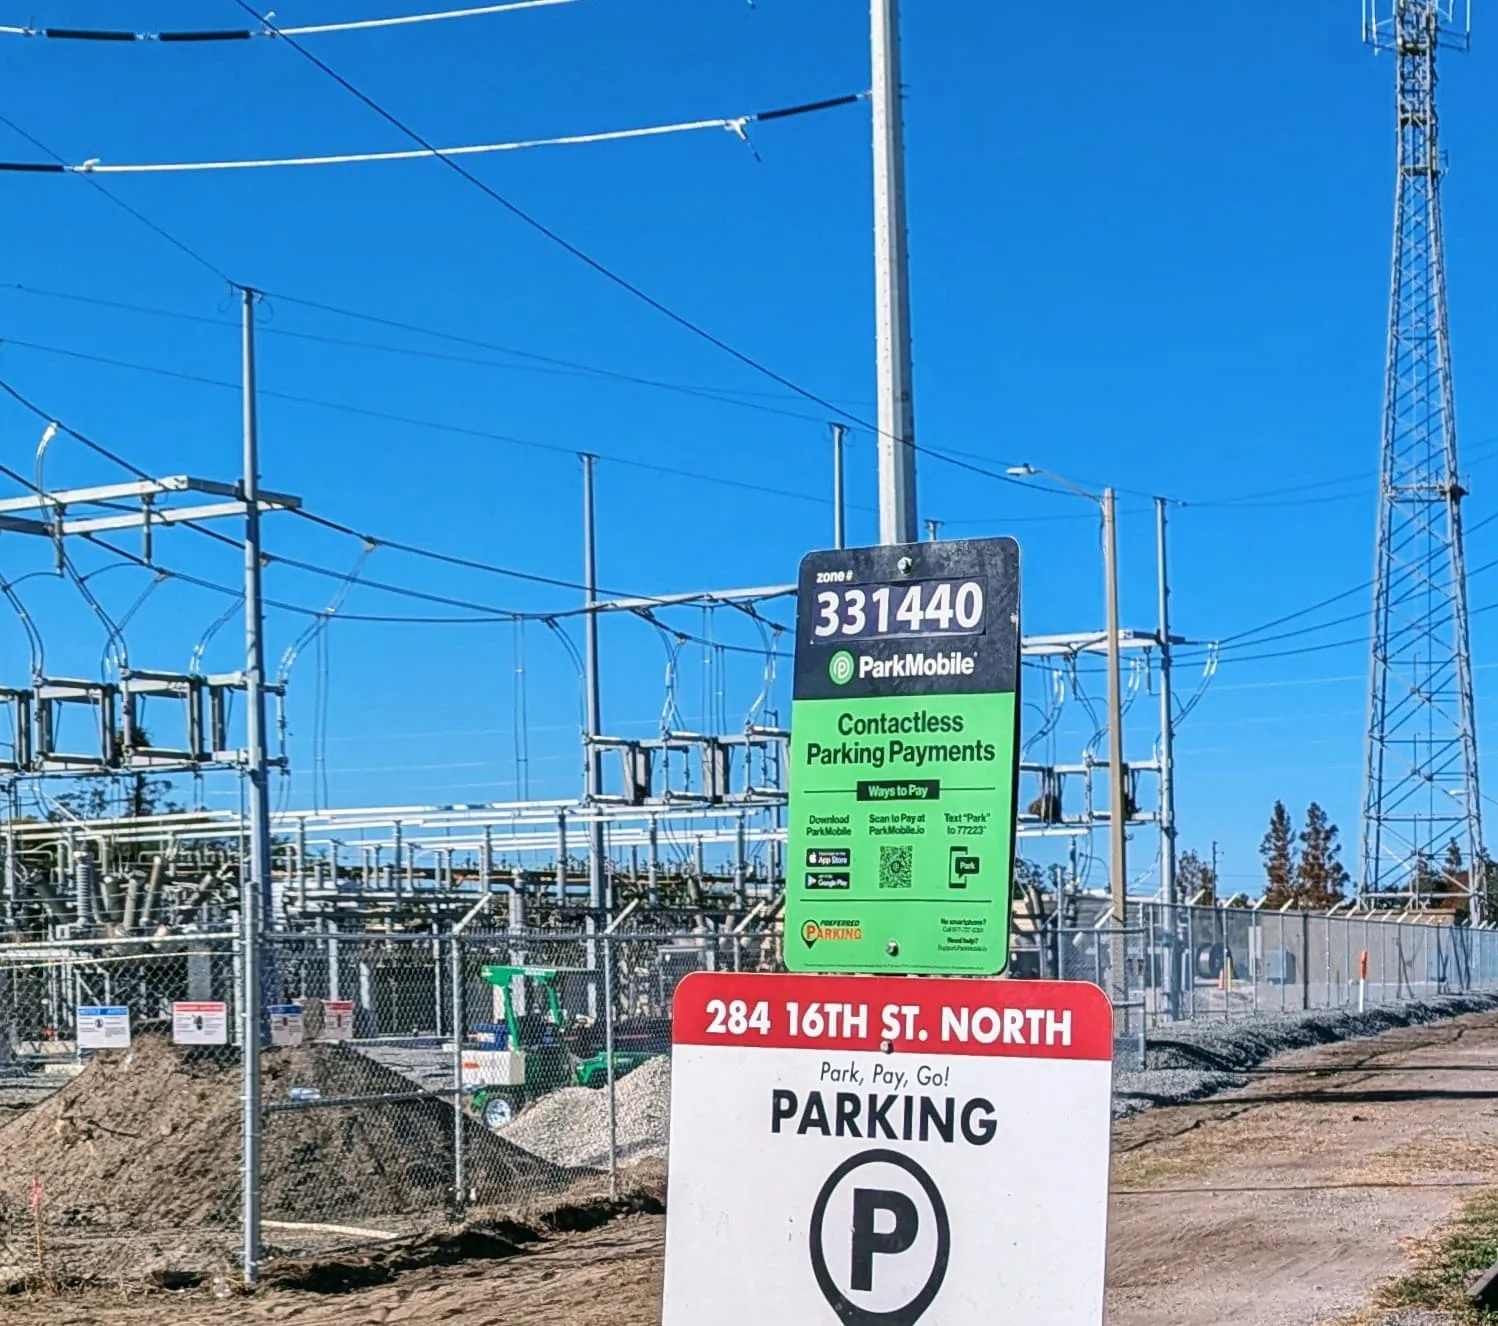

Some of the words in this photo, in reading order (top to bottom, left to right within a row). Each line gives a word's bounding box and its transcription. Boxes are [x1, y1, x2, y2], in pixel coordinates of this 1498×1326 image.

[816, 571, 844, 583] zone
[847, 570, 853, 581] #
[815, 582, 983, 637] 331440
[859, 652, 975, 679] ParkMobile
[838, 711, 964, 736] Contactless
[807, 742, 884, 768] Parking
[889, 740, 995, 767] Payments
[868, 785, 895, 799] Ways
[897, 785, 907, 797] to
[909, 784, 928, 798] Pay
[809, 815, 849, 824] Download
[869, 814, 889, 823] Scan
[891, 815, 899, 823] to
[901, 814, 916, 824] Pay
[917, 814, 925, 822] at
[944, 813, 962, 822] Text
[806, 827, 851, 836] ParkMobile
[869, 826, 925, 835] ParkMobile.io
[947, 826, 956, 835] to
[806, 925, 862, 940] PARKING
[705, 999, 771, 1035] 284
[786, 1002, 868, 1038] 16TH
[881, 1003, 928, 1041] ST.
[941, 1006, 1071, 1046] NORTH
[820, 1061, 864, 1086] Park,
[872, 1063, 908, 1091] Pay,
[917, 1065, 950, 1087] Go!
[771, 1089, 998, 1146] PARKING
